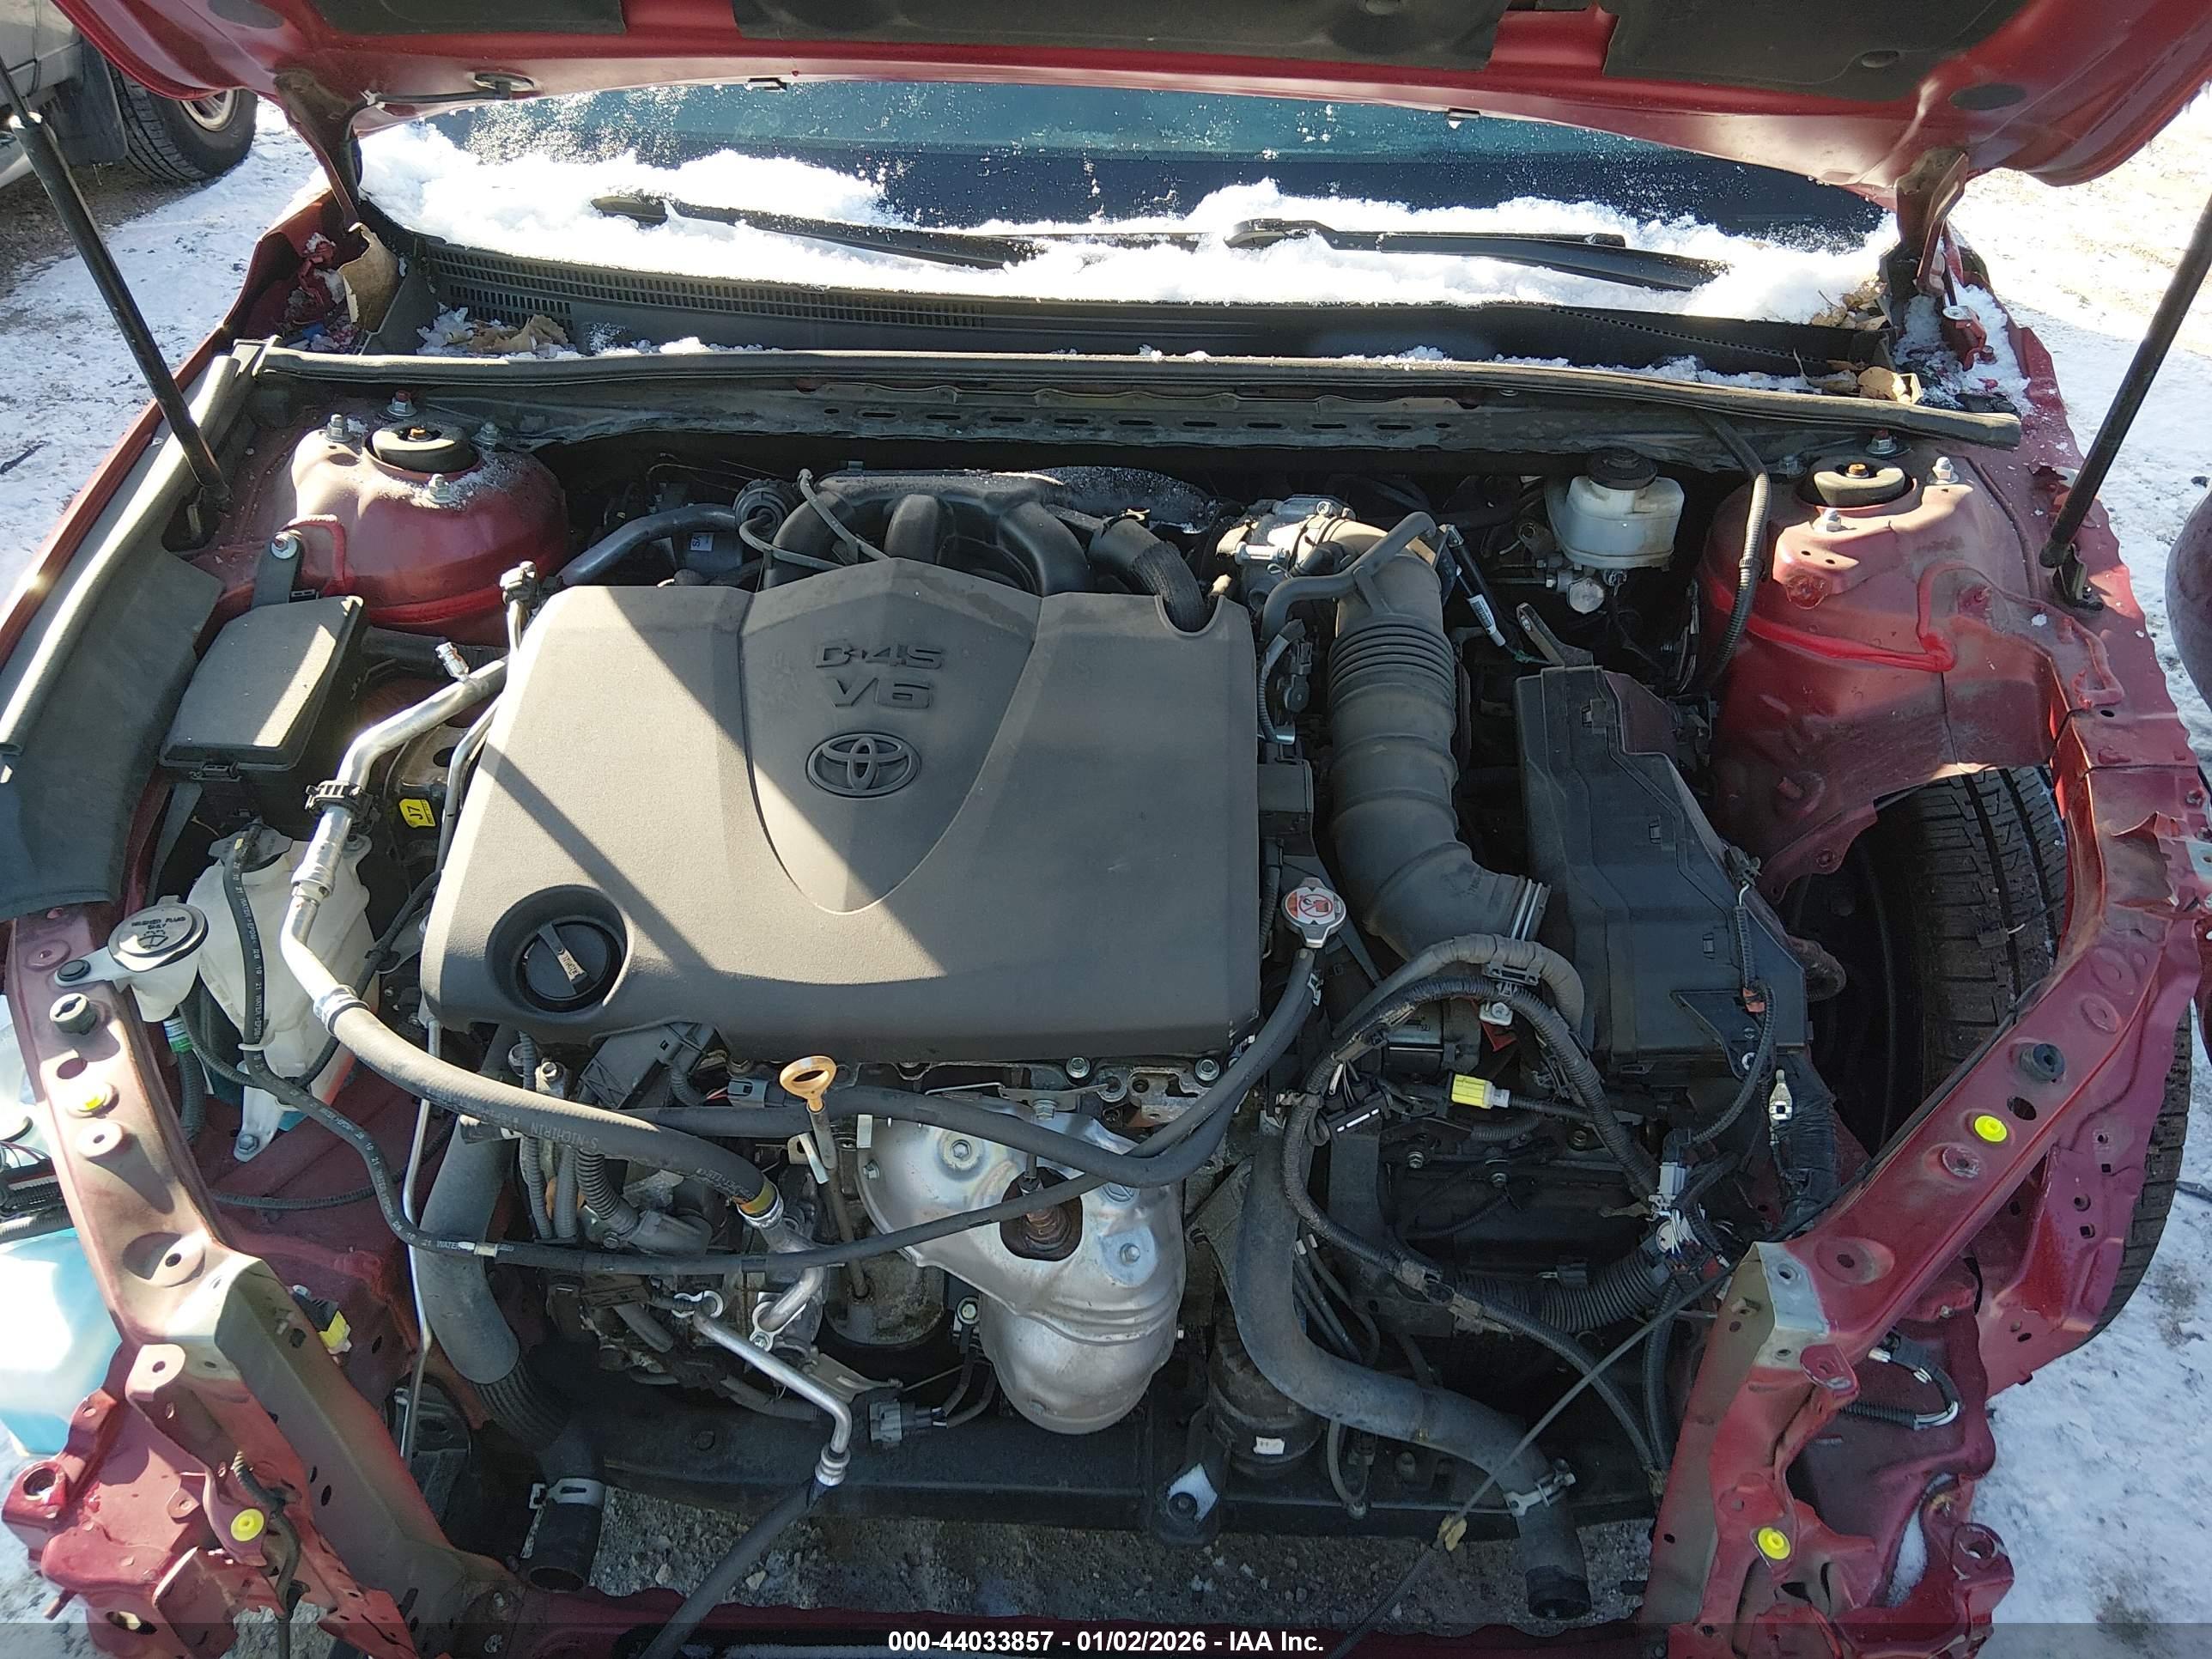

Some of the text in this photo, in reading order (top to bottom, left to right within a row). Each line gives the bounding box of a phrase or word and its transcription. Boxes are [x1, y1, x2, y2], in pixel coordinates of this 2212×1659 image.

[827, 677, 934, 708] V6
[406, 805, 423, 818] J7
[370, 1156, 380, 1166] 21
